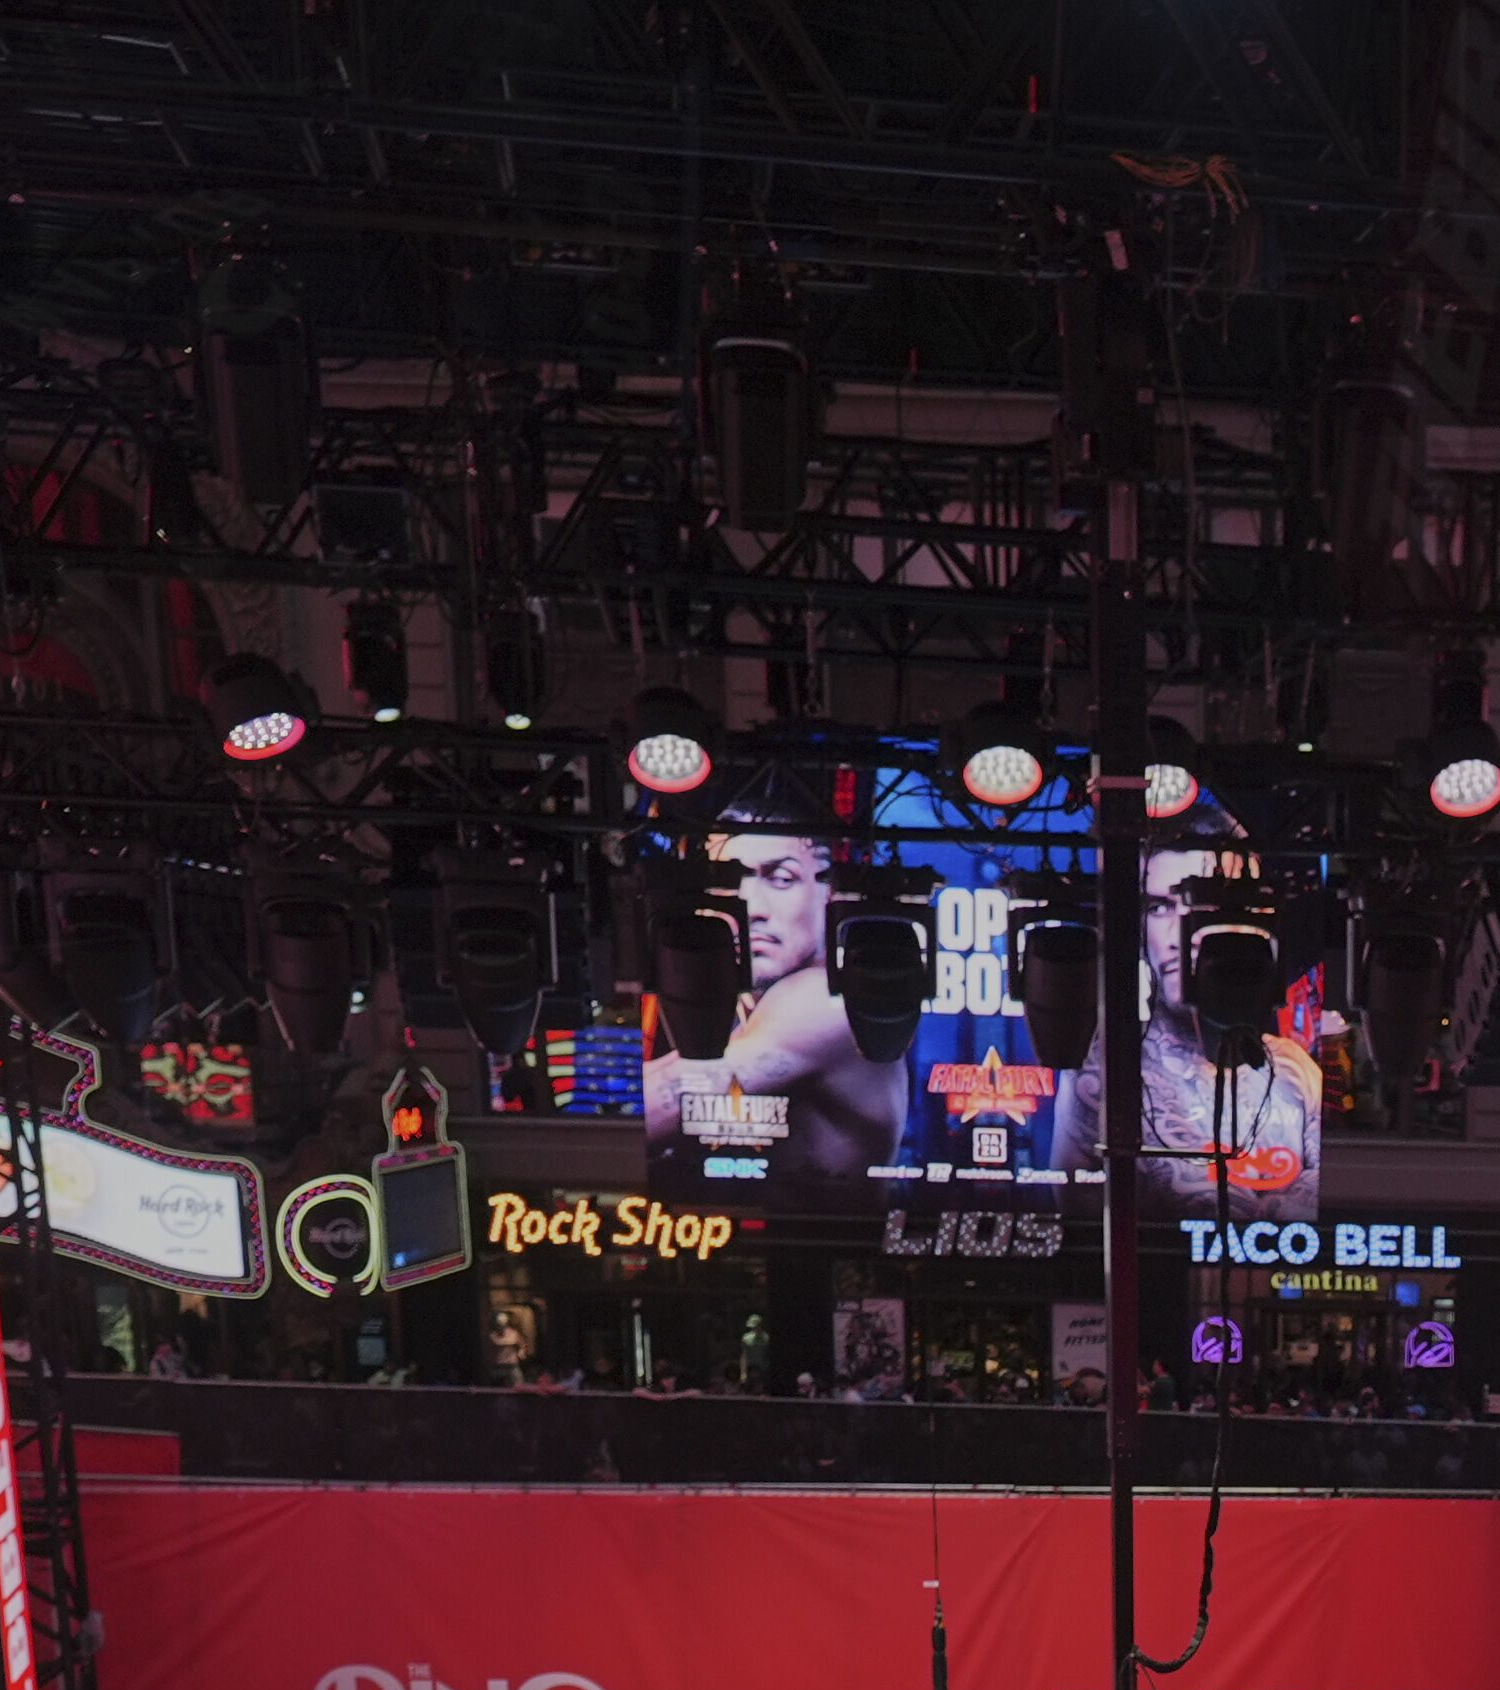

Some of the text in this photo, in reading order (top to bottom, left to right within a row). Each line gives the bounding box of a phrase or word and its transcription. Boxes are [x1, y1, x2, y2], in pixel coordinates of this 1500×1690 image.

[928, 1063, 1055, 1097] FATAL FURY
[681, 1093, 790, 1124] FATAL FURY
[139, 1193, 226, 1218] Hard Rock
[488, 1192, 733, 1261] Rock Shop
[882, 1210, 1063, 1258] LIDS
[1180, 1219, 1462, 1269] TACO BELL
[1270, 1269, 1378, 1292] cantina
